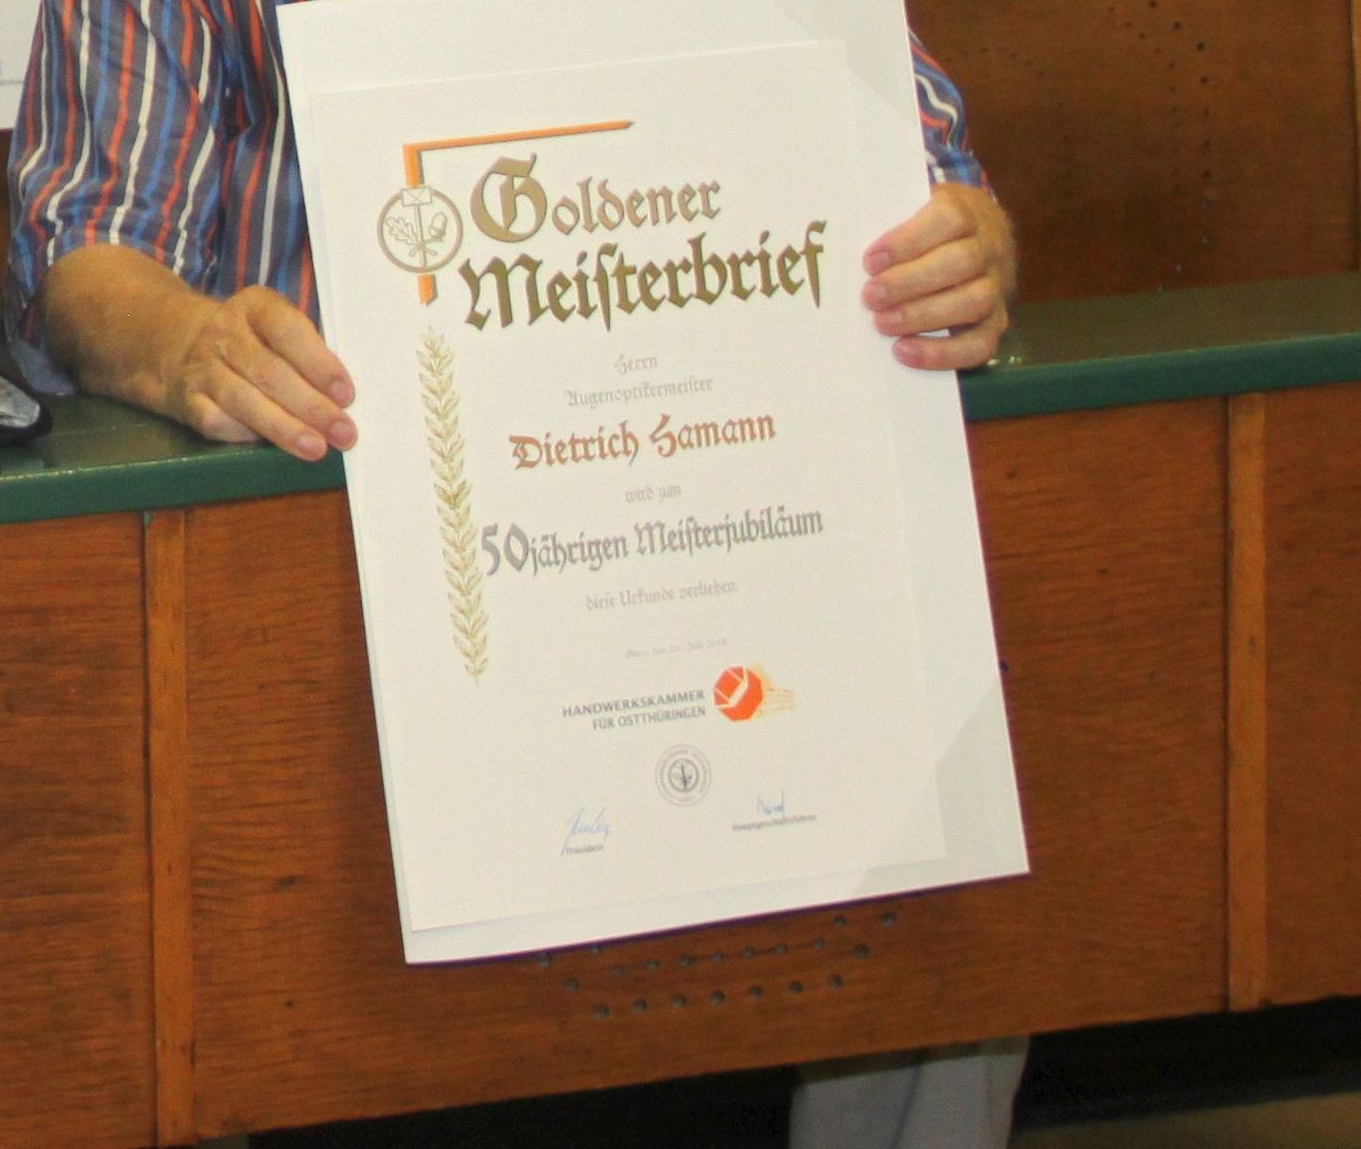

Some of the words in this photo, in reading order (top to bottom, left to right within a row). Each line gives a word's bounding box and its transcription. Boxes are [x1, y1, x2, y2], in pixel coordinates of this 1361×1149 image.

[471, 153, 721, 242] Goldener
[614, 354, 658, 374] Herrn
[508, 419, 639, 470] Dietrich
[648, 413, 776, 457] Hamann
[481, 522, 629, 577] 50jährigen
[562, 689, 705, 717] HANDWERKSKAMMER
[592, 717, 614, 730] FÜR
[618, 705, 706, 728] OSTTHÜRINGEN
